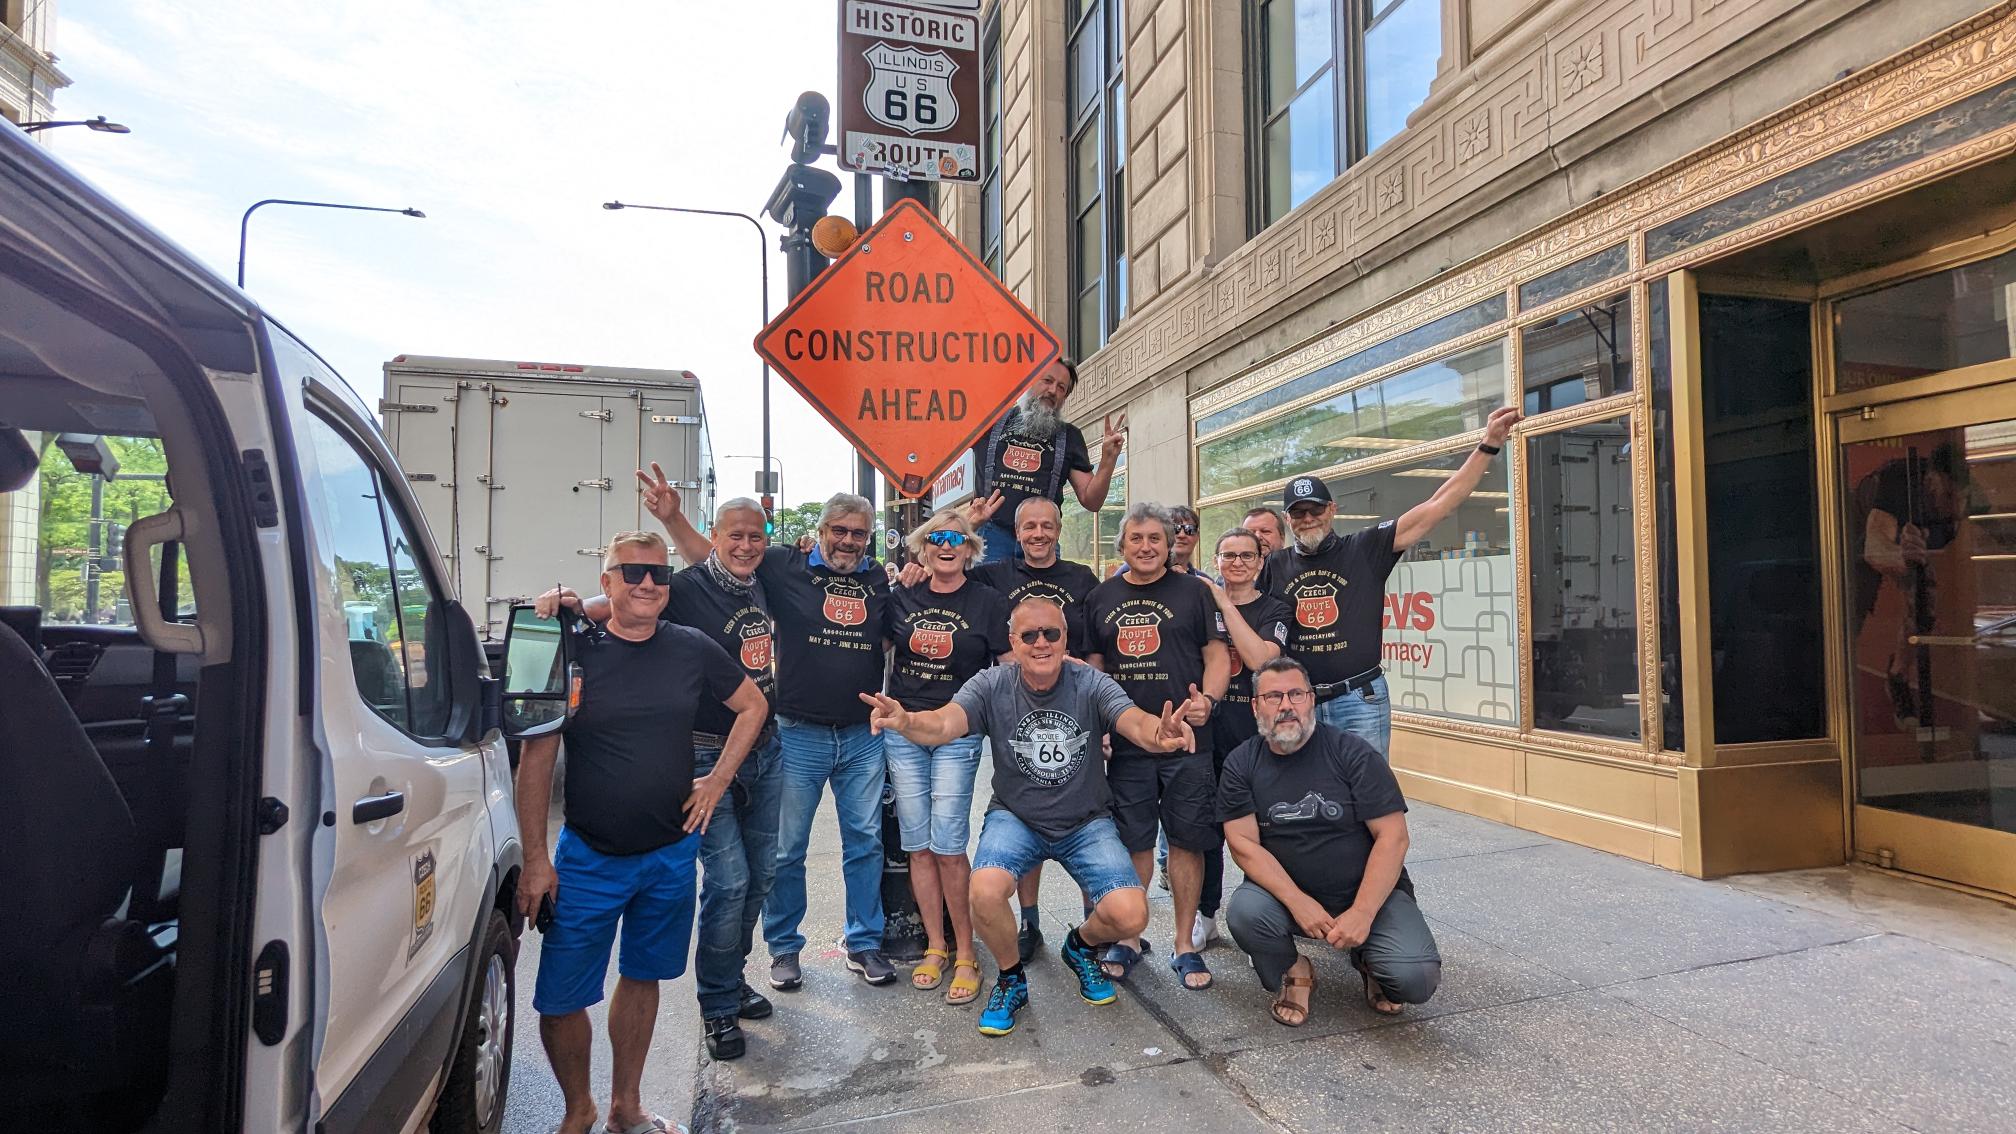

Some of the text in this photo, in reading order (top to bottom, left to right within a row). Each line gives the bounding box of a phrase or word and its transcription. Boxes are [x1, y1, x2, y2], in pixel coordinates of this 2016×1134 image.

[856, 8, 964, 43] HISTORIC
[878, 52, 944, 72] ILLINOIS
[884, 89, 937, 125] 66
[866, 271, 954, 304] ROAD
[784, 328, 1035, 363] CONSTRUCTION
[857, 388, 968, 421] AHEAD
[1008, 447, 1037, 461] ROUTE
[1012, 458, 1028, 469] 66
[1297, 485, 1311, 495] 66
[833, 587, 857, 597] CZECH
[829, 597, 860, 609] ROUTE
[1122, 600, 1140, 608] SLOVAK
[1300, 600, 1331, 612] ROUTE
[835, 609, 853, 621] 66
[1125, 617, 1150, 625] CZECH
[1308, 612, 1325, 624] 66
[746, 626, 765, 637] CZECH
[822, 628, 863, 637] ASSOCIATION
[922, 623, 947, 631] CZECH
[915, 631, 947, 643] ROUTE
[1121, 629, 1153, 640] ROUTE
[1299, 631, 1336, 641] ASSOCIATION
[744, 638, 769, 653] ROUTE
[808, 635, 821, 644] MAY
[838, 640, 852, 649] JUNE
[1128, 640, 1146, 652] 66
[1312, 644, 1324, 652] JUNE
[1334, 641, 1347, 650] 2023
[921, 643, 938, 655] 66
[1382, 642, 1433, 668] macy
[751, 651, 765, 665] 66
[1119, 661, 1157, 670] ASSOCIATION
[1039, 743, 1065, 763] 66
[1018, 757, 1052, 785] CALIFORNIA
[1028, 761, 1057, 778] MISSOURI
[419, 891, 431, 919] 66
